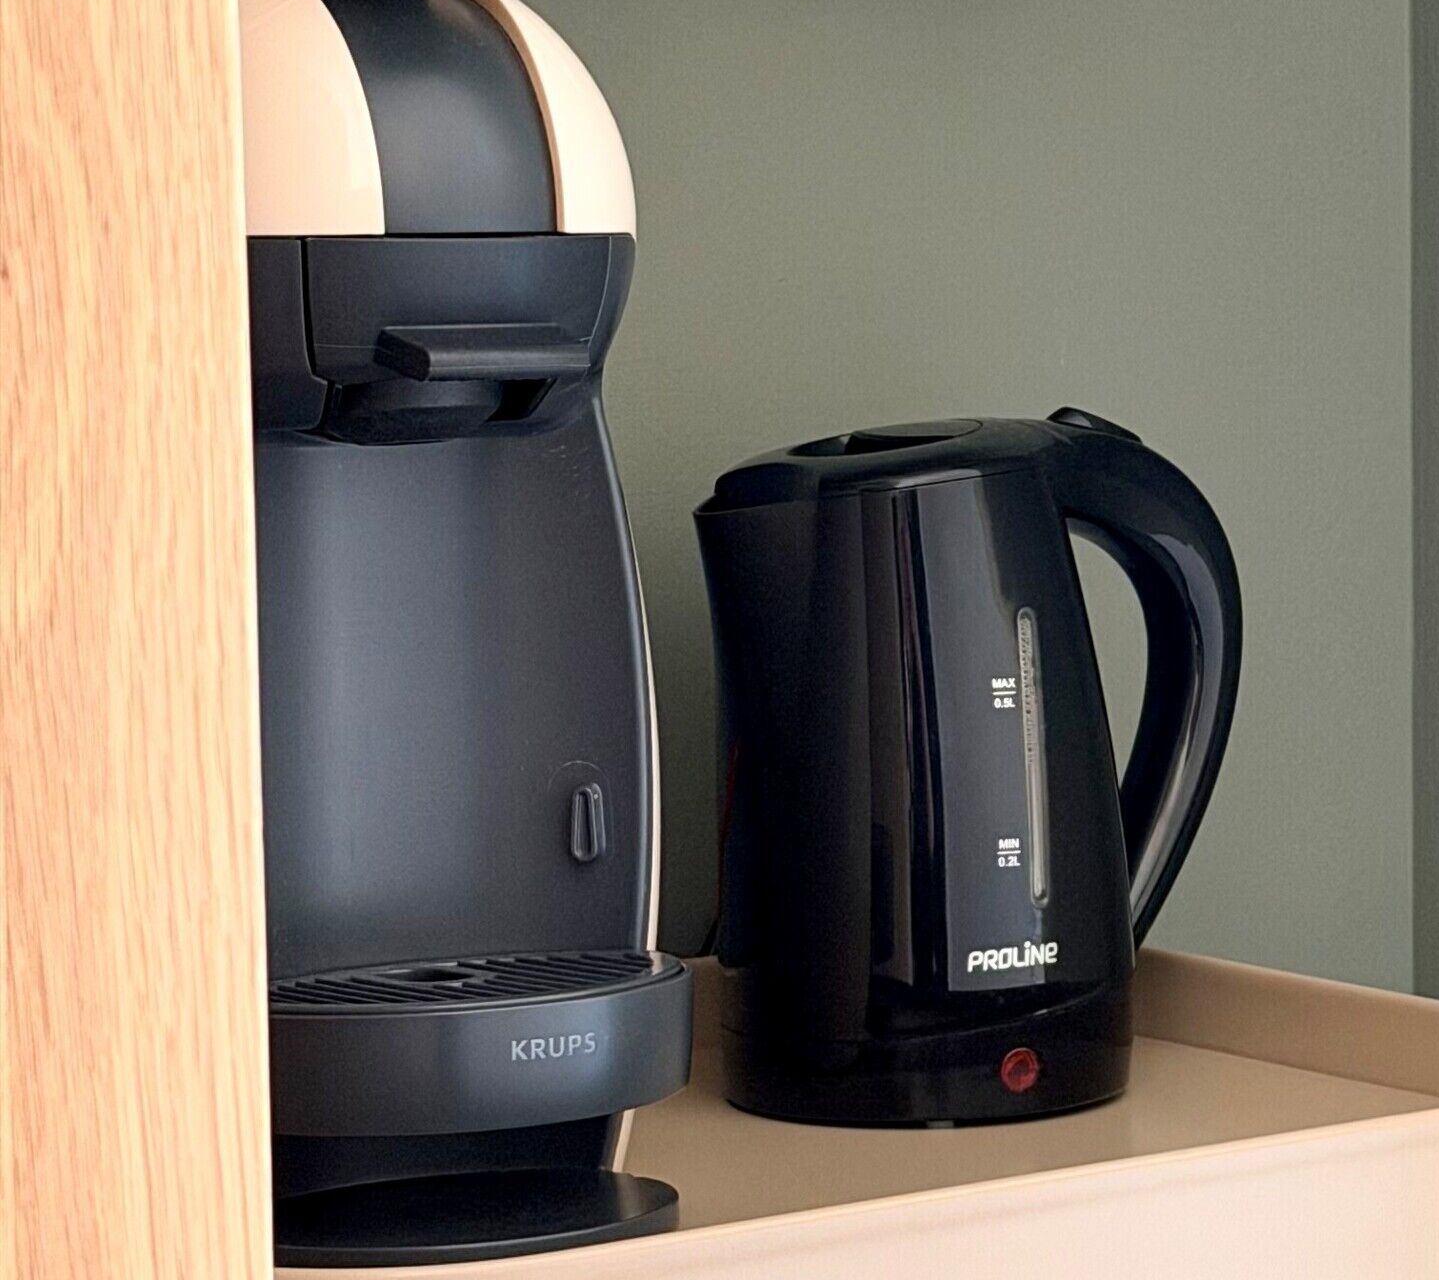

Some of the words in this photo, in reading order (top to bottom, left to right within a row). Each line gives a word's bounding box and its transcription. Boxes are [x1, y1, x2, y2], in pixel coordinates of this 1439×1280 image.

[992, 677, 1016, 689] MAX
[994, 698, 1016, 708] 0.5L
[998, 838, 1020, 849] MIN
[997, 856, 1021, 867] 0.2L
[511, 1031, 597, 1061] KRUPS
